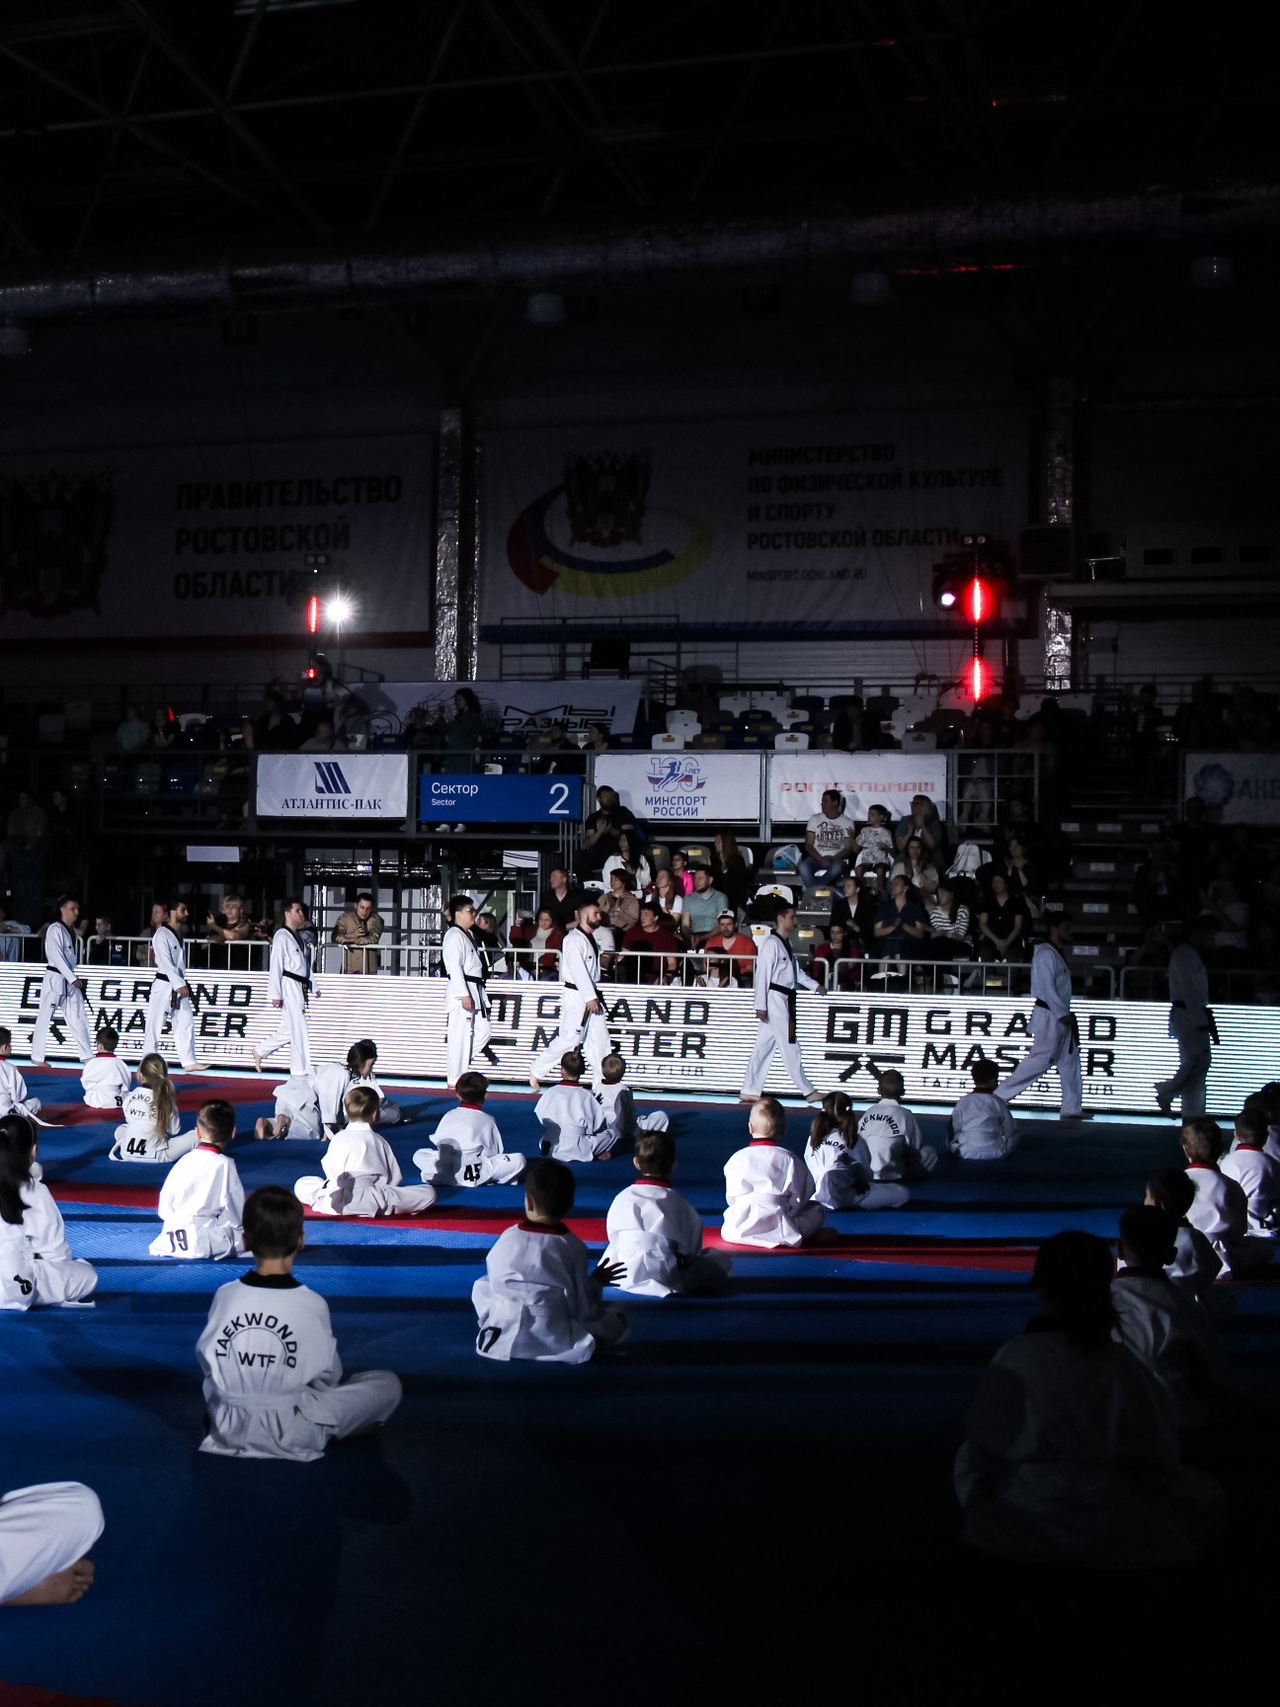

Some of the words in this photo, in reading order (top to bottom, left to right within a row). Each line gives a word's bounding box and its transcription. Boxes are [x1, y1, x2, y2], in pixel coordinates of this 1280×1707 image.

[749, 443, 896, 466] МИНИСТЕРСТВО
[176, 475, 402, 510] ПРАВИТЕЛЬСТВО
[748, 475, 772, 494] ПО
[777, 467, 903, 494] ФИЗИЧЕСКОЙ
[909, 468, 1004, 489] КУЛЬТУРЕ
[747, 504, 760, 522] И
[766, 502, 837, 521] СПОРТУ
[175, 514, 350, 555] РОСТОВСКОЙ
[747, 526, 867, 550] РОСТОВСКОЙ
[872, 527, 959, 549] ОБЛАСТИ
[431, 781, 479, 798] Сектор
[548, 783, 570, 815] 2
[645, 796, 707, 807] МИНСПОРТ
[282, 798, 382, 811] АТЛАНТИС-ПАК
[431, 798, 457, 807] Sector
[652, 807, 699, 817] РОССИИ
[100, 980, 252, 1007] GRND
[537, 996, 709, 1025] GAND
[825, 1006, 909, 1046] GM
[926, 1010, 1117, 1041] GRAD
[922, 1042, 1116, 1077] MASR
[126, 1137, 147, 1156] 44
[215, 1312, 298, 1369] TAEKWONDO
[238, 1351, 277, 1368] WTF
